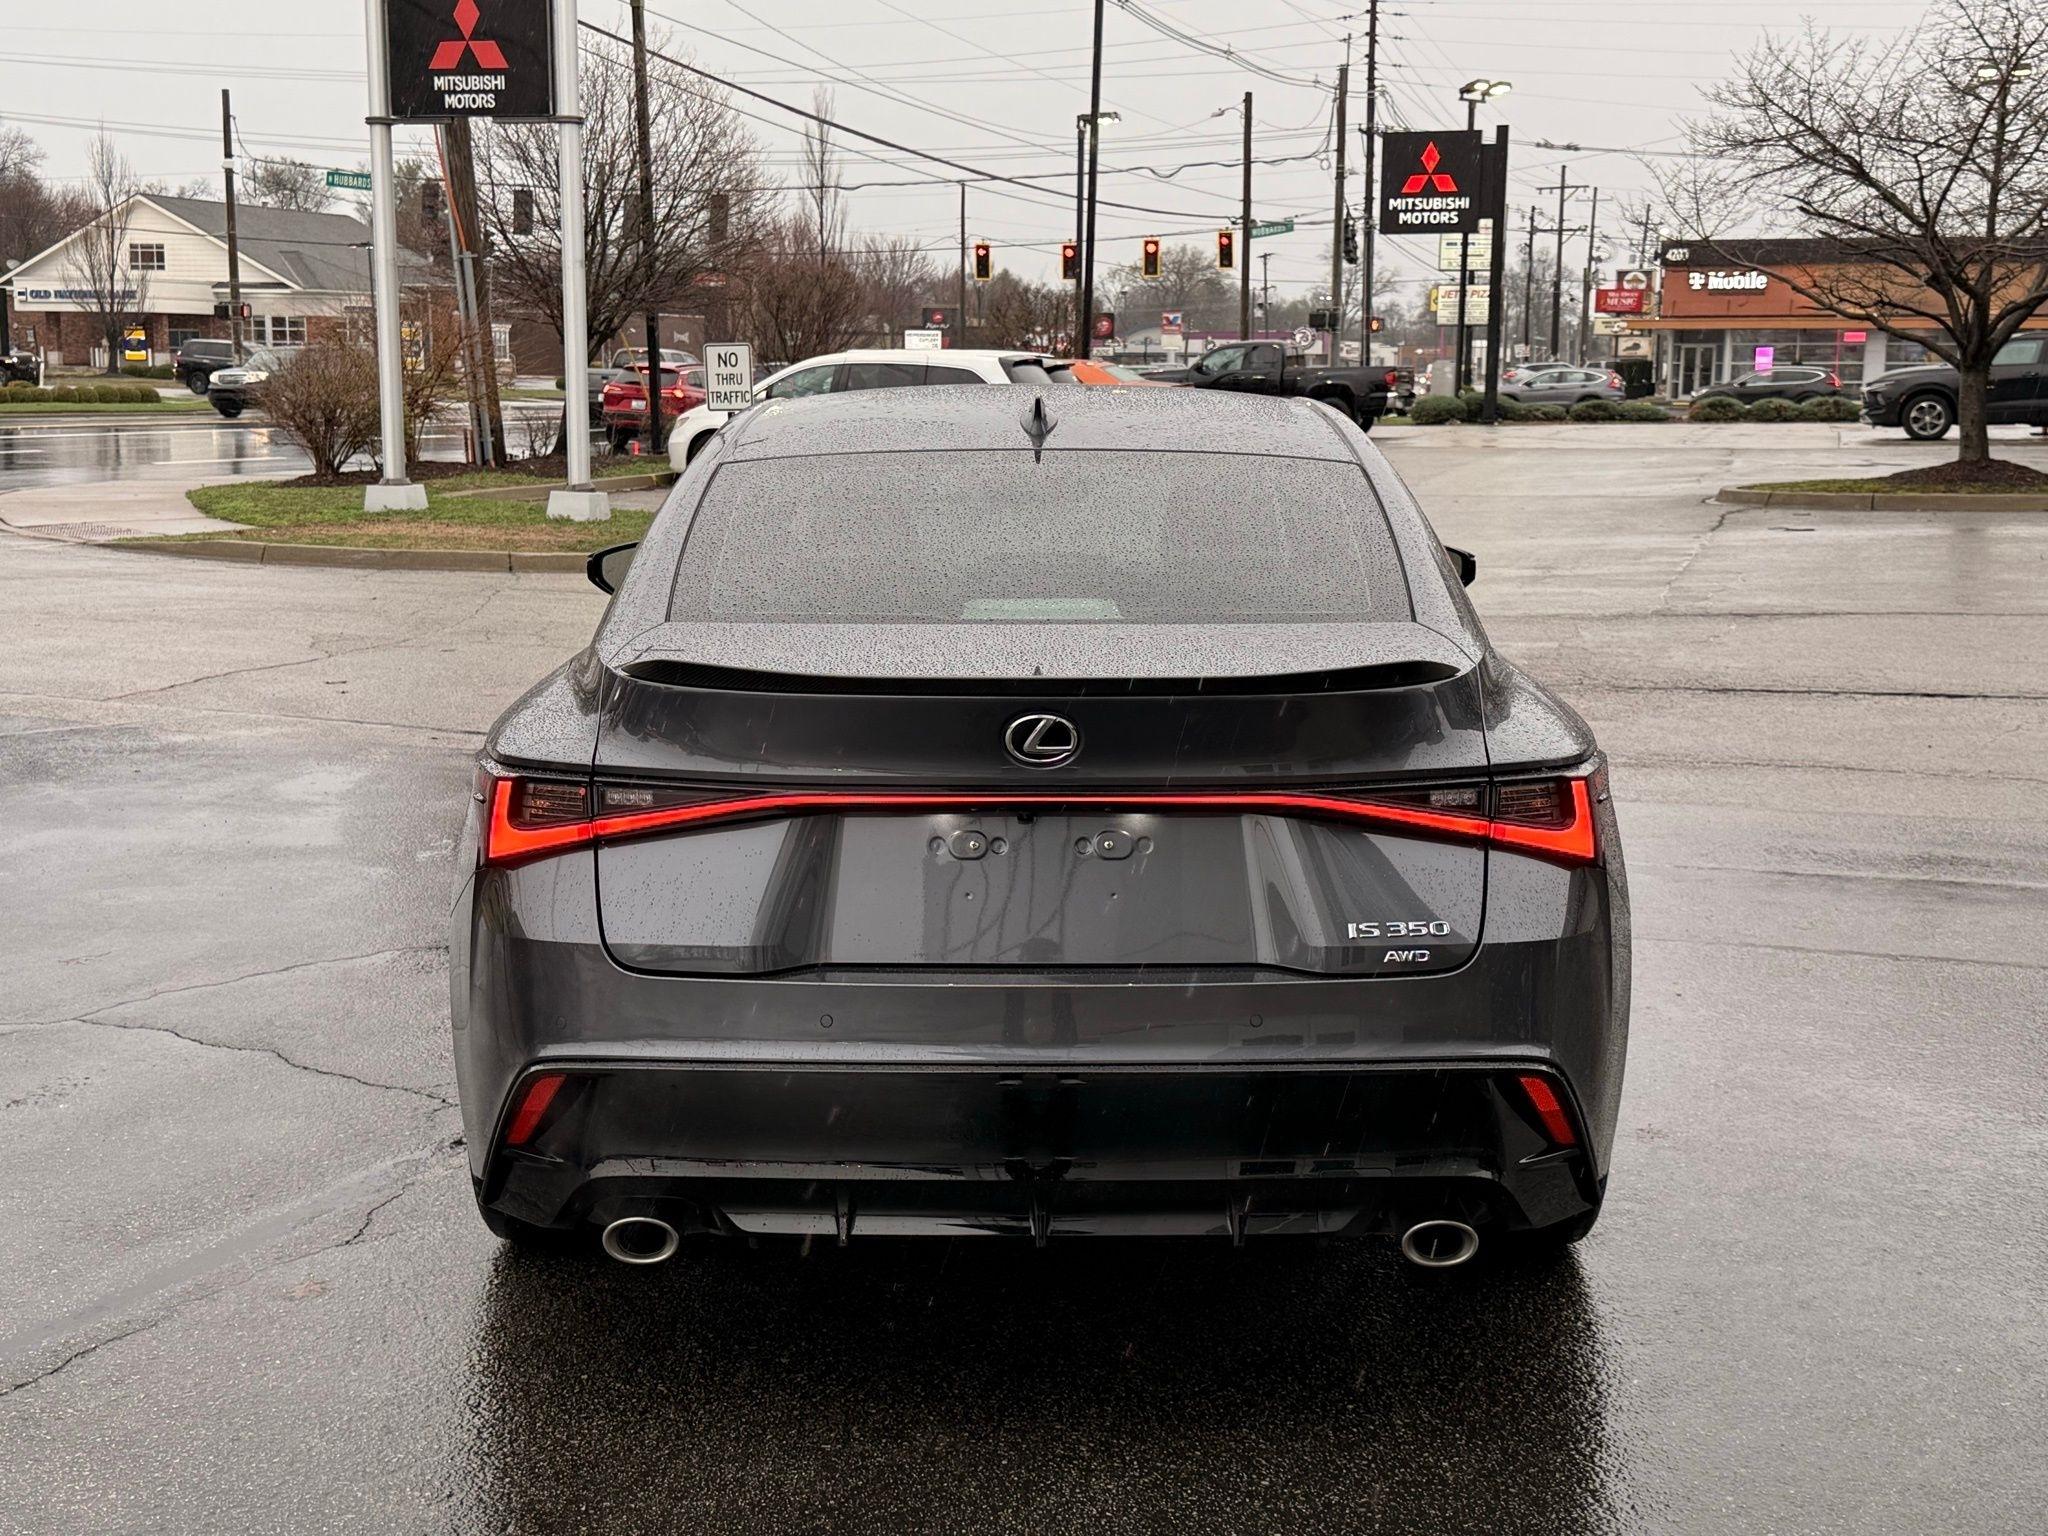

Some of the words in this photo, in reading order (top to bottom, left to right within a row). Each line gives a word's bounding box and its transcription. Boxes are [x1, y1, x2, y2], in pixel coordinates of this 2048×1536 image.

[433, 74, 506, 92] MITSUBISHI
[444, 93, 496, 109] MOTORS
[333, 174, 371, 189] HUBBARDS
[1388, 196, 1470, 211] MITSUBISHI
[1398, 211, 1460, 225] MOTORS
[1707, 270, 1768, 290] Mobile
[717, 351, 739, 368] NO
[714, 372, 743, 386] THRU
[709, 390, 751, 405] TRAFFIC
[1347, 921, 1381, 939] IS
[1385, 919, 1451, 938] 350
[1383, 949, 1431, 963] AWD
